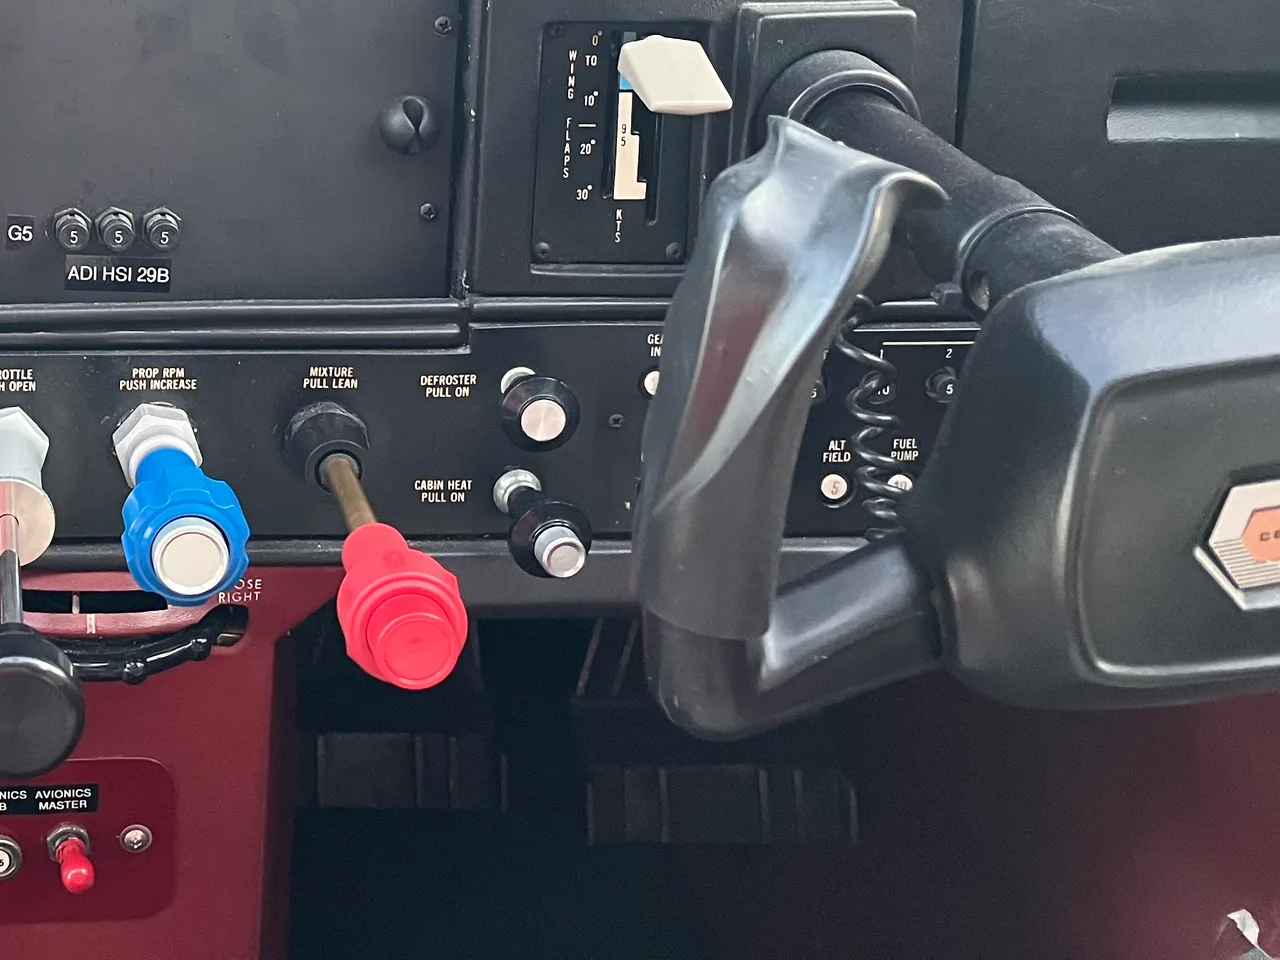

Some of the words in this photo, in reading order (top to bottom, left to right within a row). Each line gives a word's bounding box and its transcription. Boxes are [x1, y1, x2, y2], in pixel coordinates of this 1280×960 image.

[7, 225, 33, 243] G5
[68, 265, 97, 282] ADI
[102, 267, 132, 283] HSI
[136, 267, 170, 283] 29B
[131, 367, 155, 379] PROP
[161, 367, 185, 379] RPM
[310, 366, 353, 377] MIXTURE
[9, 380, 36, 392] OPEN
[119, 378, 147, 390] PUSH
[149, 378, 197, 390] INCREASE
[303, 378, 328, 389] PULL
[333, 378, 358, 389] LEAN
[420, 375, 477, 386] DEFROSTER
[426, 387, 451, 398] PULL
[455, 387, 469, 397] ON
[829, 440, 847, 450] ALT
[894, 439, 918, 449] FUEL
[823, 451, 851, 462] FIELD
[414, 480, 444, 492] CABIN
[448, 480, 472, 491] HEAT
[421, 491, 448, 503] PULL
[450, 490, 465, 503] ON
[234, 578, 263, 590] OSE
[218, 590, 262, 603] RIGHT
[35, 788, 92, 800] AVIONICS
[39, 799, 87, 811] MASTER
